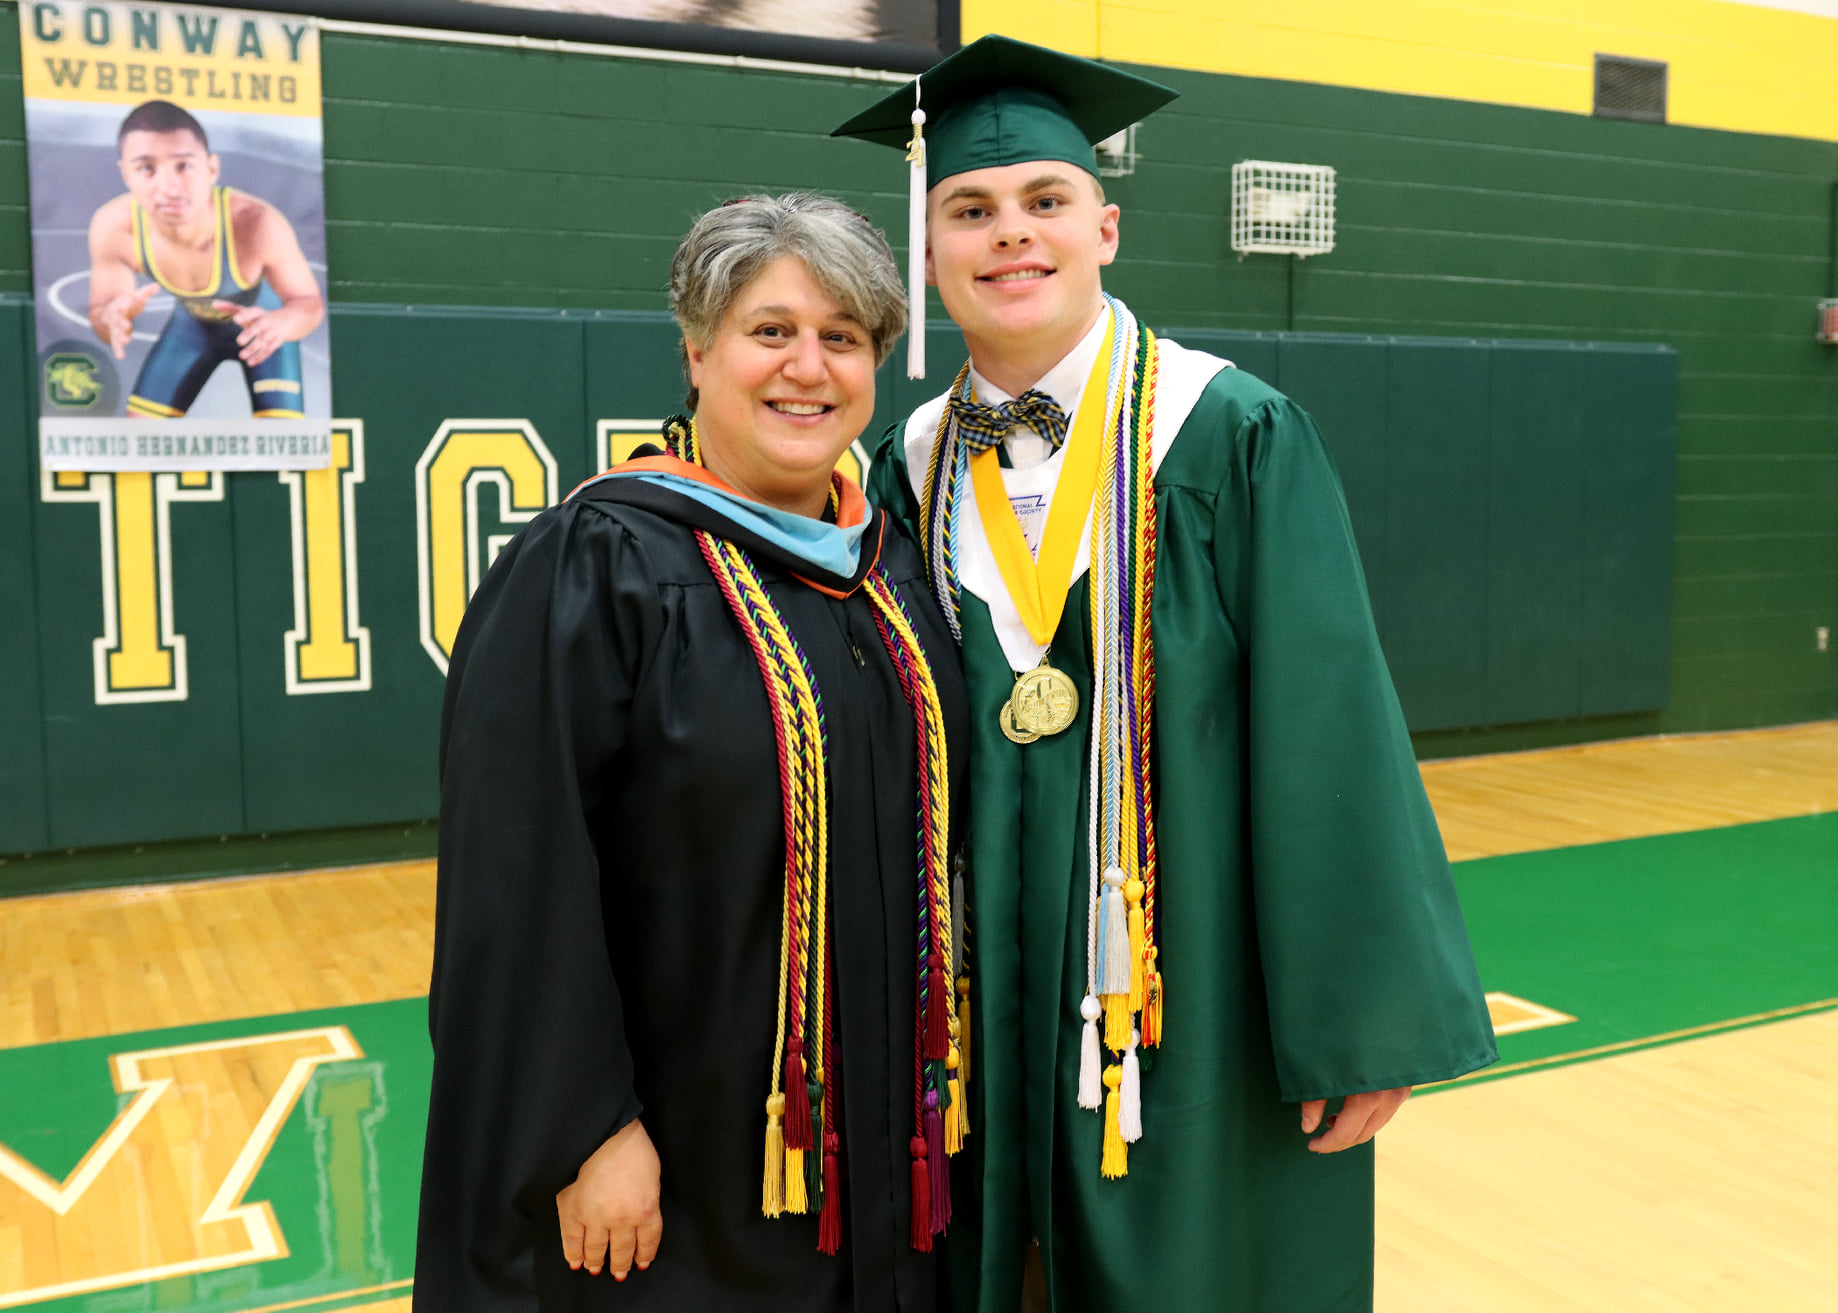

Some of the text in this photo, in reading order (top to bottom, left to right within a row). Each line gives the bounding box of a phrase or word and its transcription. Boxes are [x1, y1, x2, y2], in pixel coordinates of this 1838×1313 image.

[33, 3, 307, 62] CONWAY
[44, 57, 297, 104] WRESTLING
[44, 435, 129, 456] ANTONIO
[136, 435, 249, 456] HERNANDEZ
